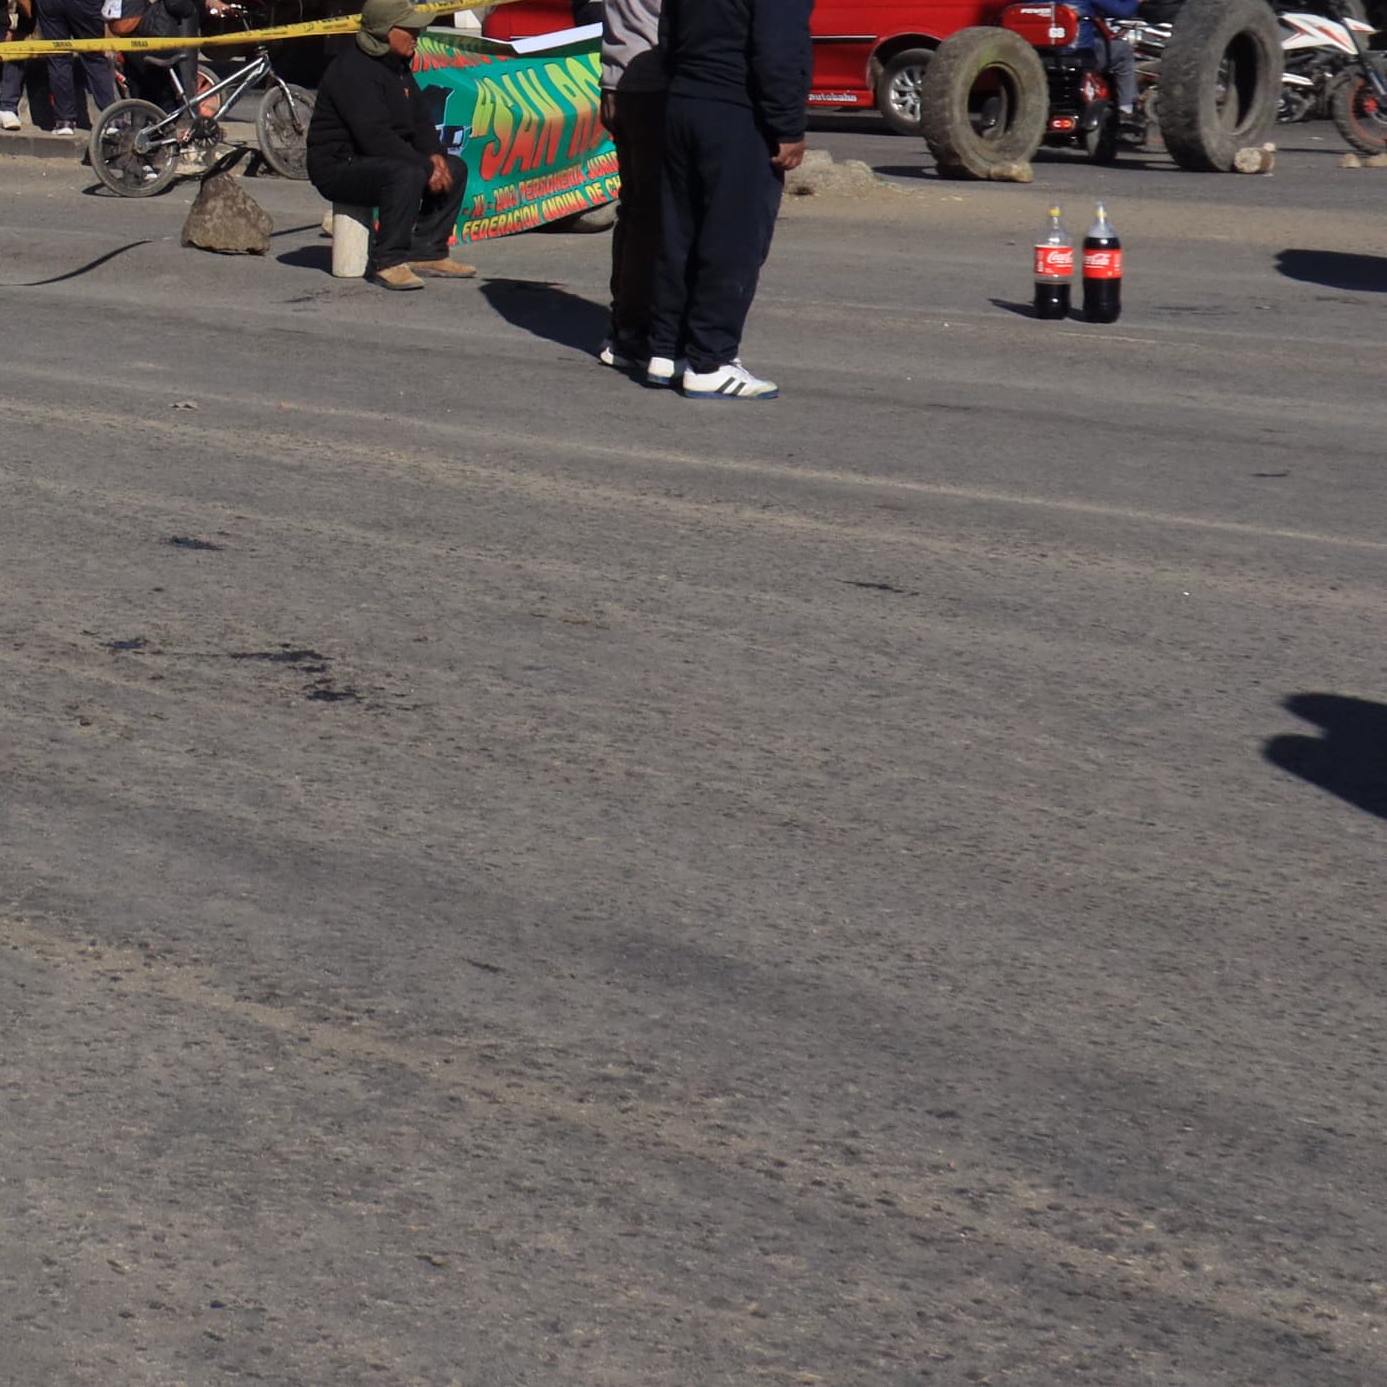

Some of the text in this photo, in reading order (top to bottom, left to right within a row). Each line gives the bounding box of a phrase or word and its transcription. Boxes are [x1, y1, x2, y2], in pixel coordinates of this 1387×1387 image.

[462, 204, 542, 242] FEDERACION
[542, 189, 589, 224] ANDINA
[588, 183, 603, 205] DE
